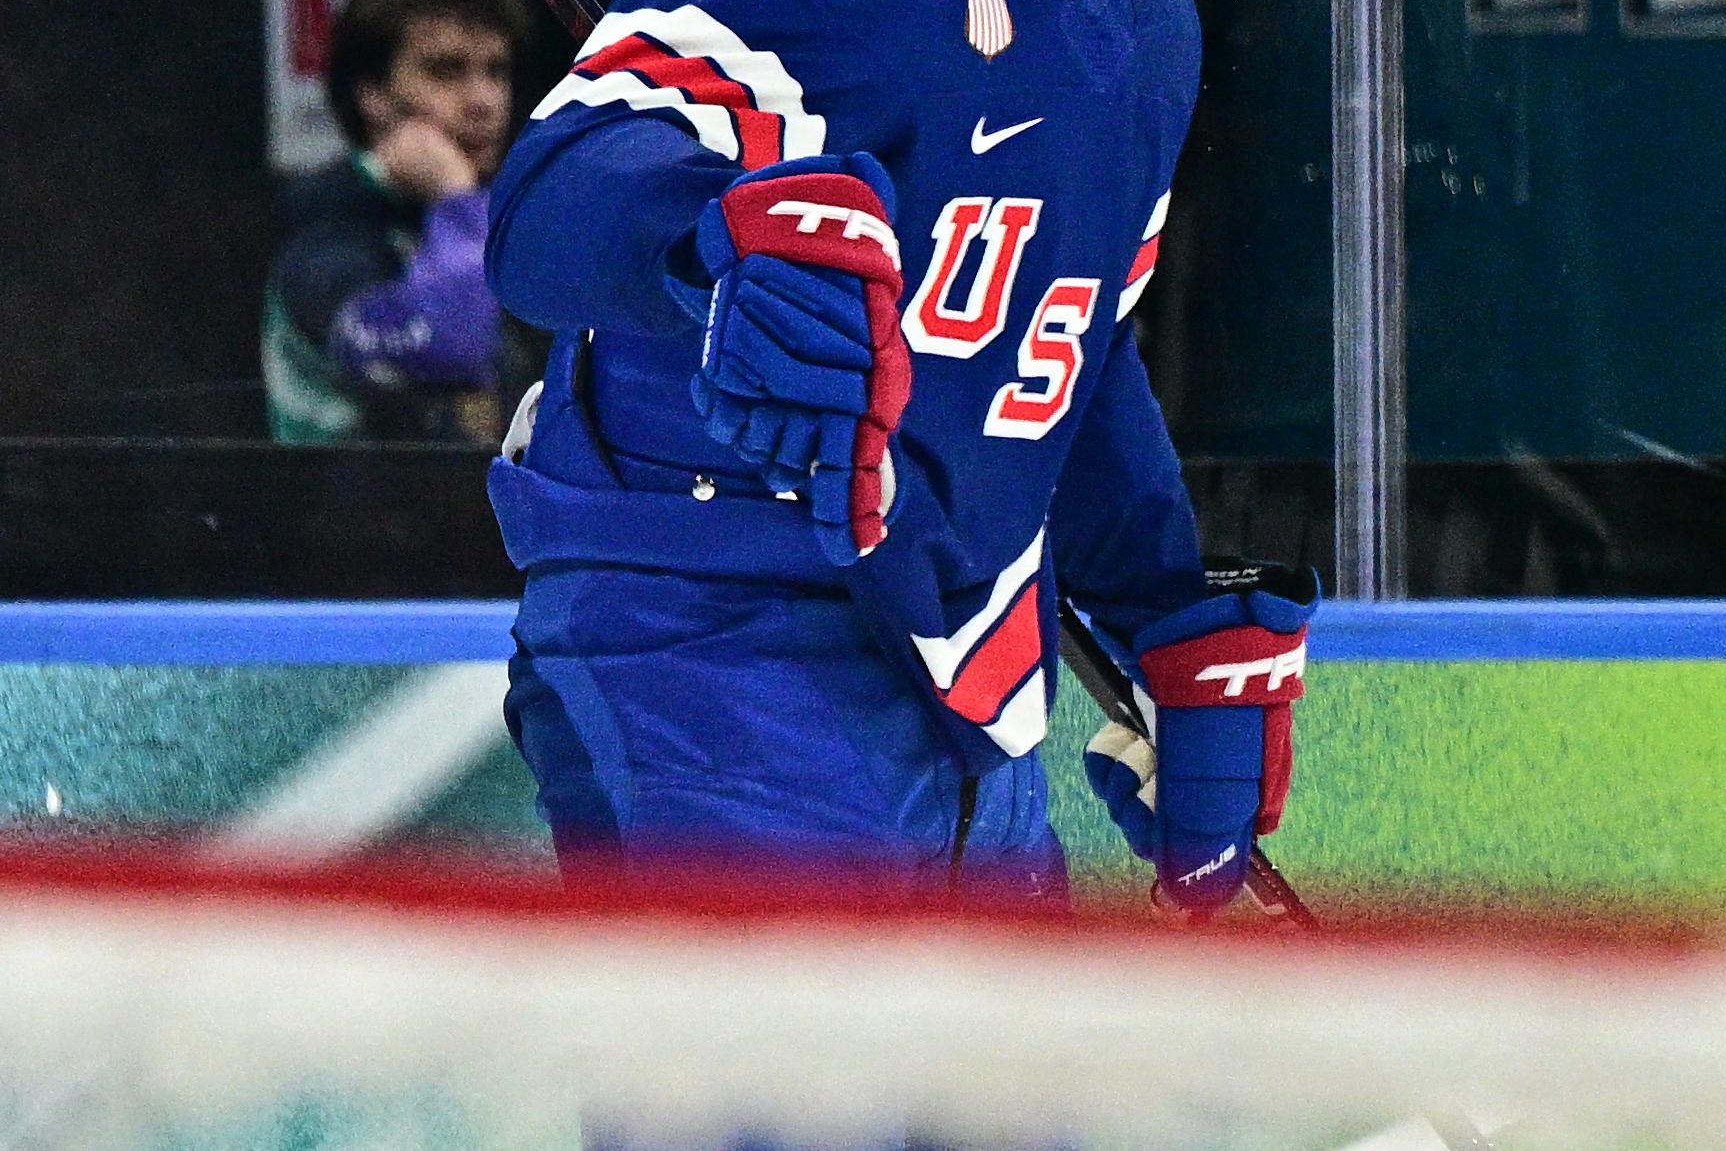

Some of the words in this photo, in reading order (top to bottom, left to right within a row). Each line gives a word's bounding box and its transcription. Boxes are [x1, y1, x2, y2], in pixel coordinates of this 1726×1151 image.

[767, 200, 901, 272] TR
[900, 196, 1102, 441] US
[1194, 640, 1306, 697] TR
